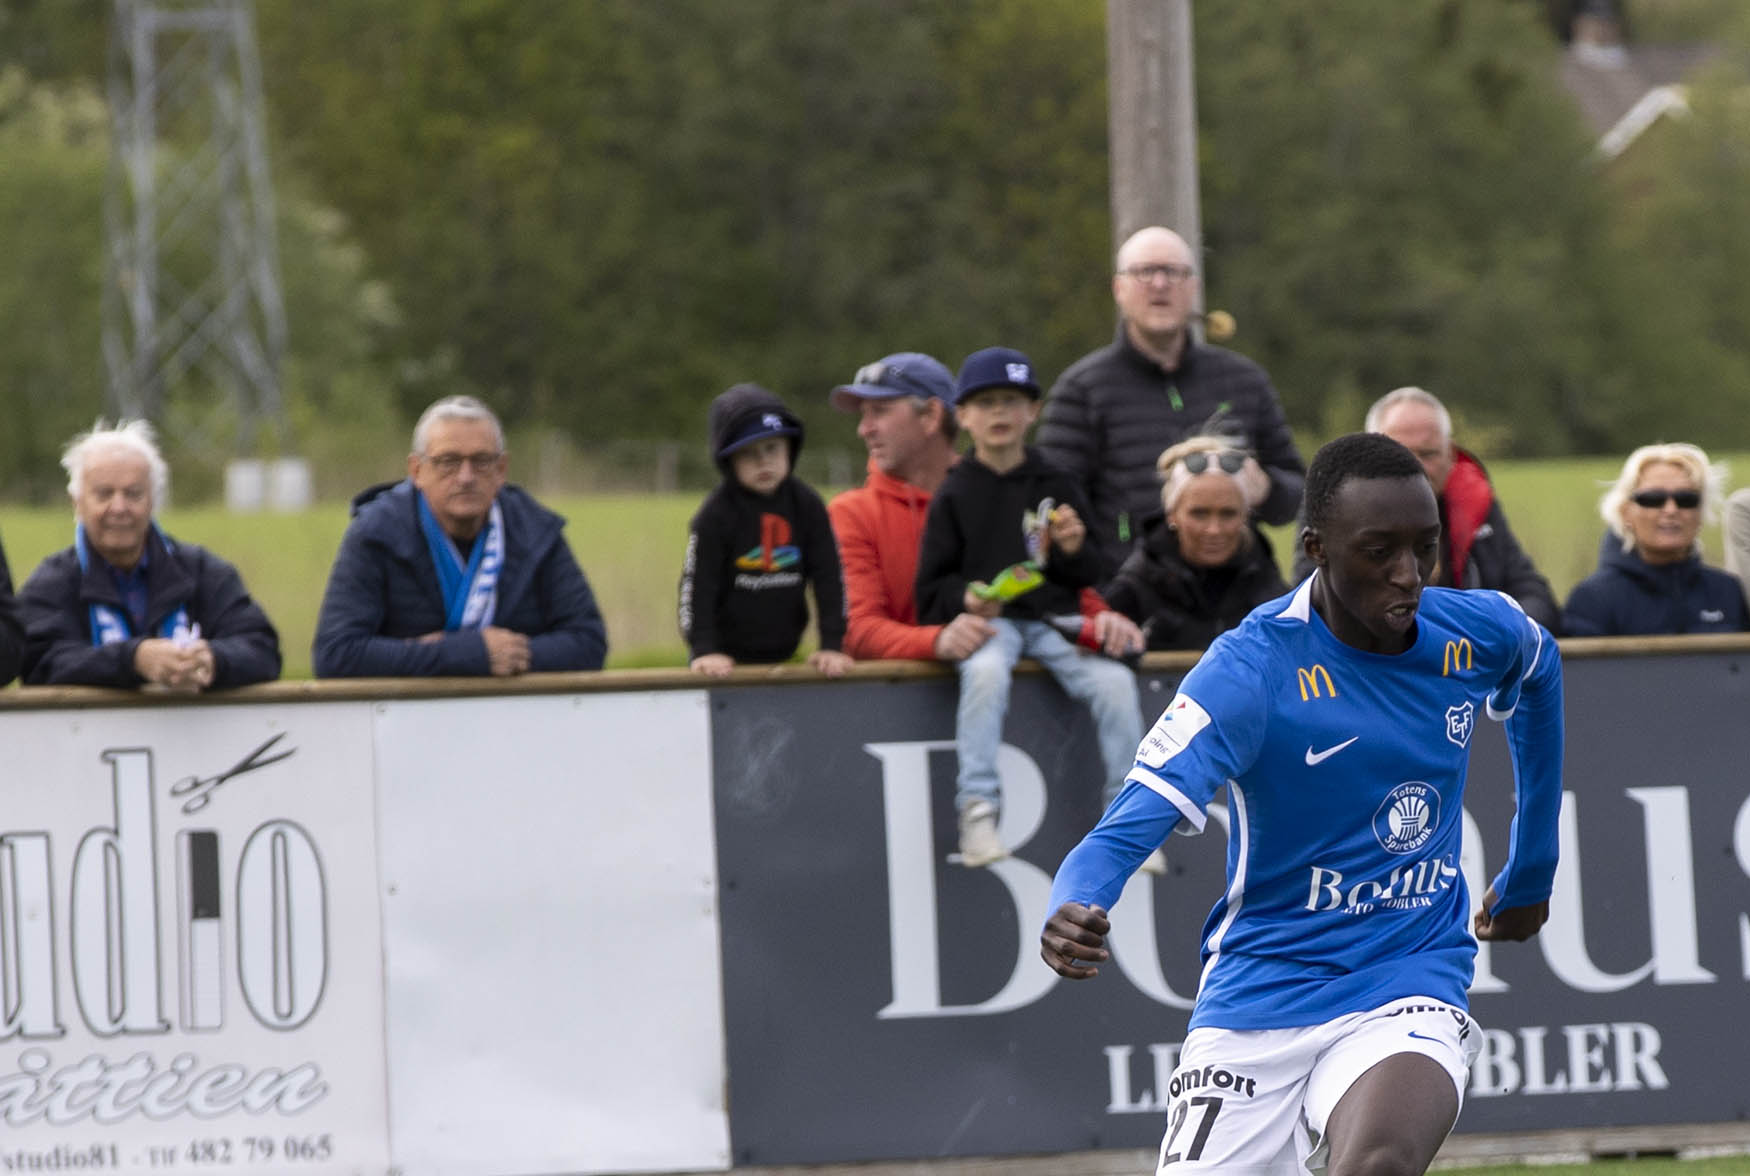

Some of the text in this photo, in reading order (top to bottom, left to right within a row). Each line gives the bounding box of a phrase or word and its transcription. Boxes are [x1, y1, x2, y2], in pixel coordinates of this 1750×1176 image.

[1391, 785, 1428, 801] Totens
[1384, 826, 1434, 852] Sparebank
[1167, 1063, 1257, 1099] omfort
[1162, 1096, 1224, 1168] 27
[186, 1138, 234, 1164] 482
[243, 1137, 275, 1161] 79
[284, 1134, 333, 1160] 065
